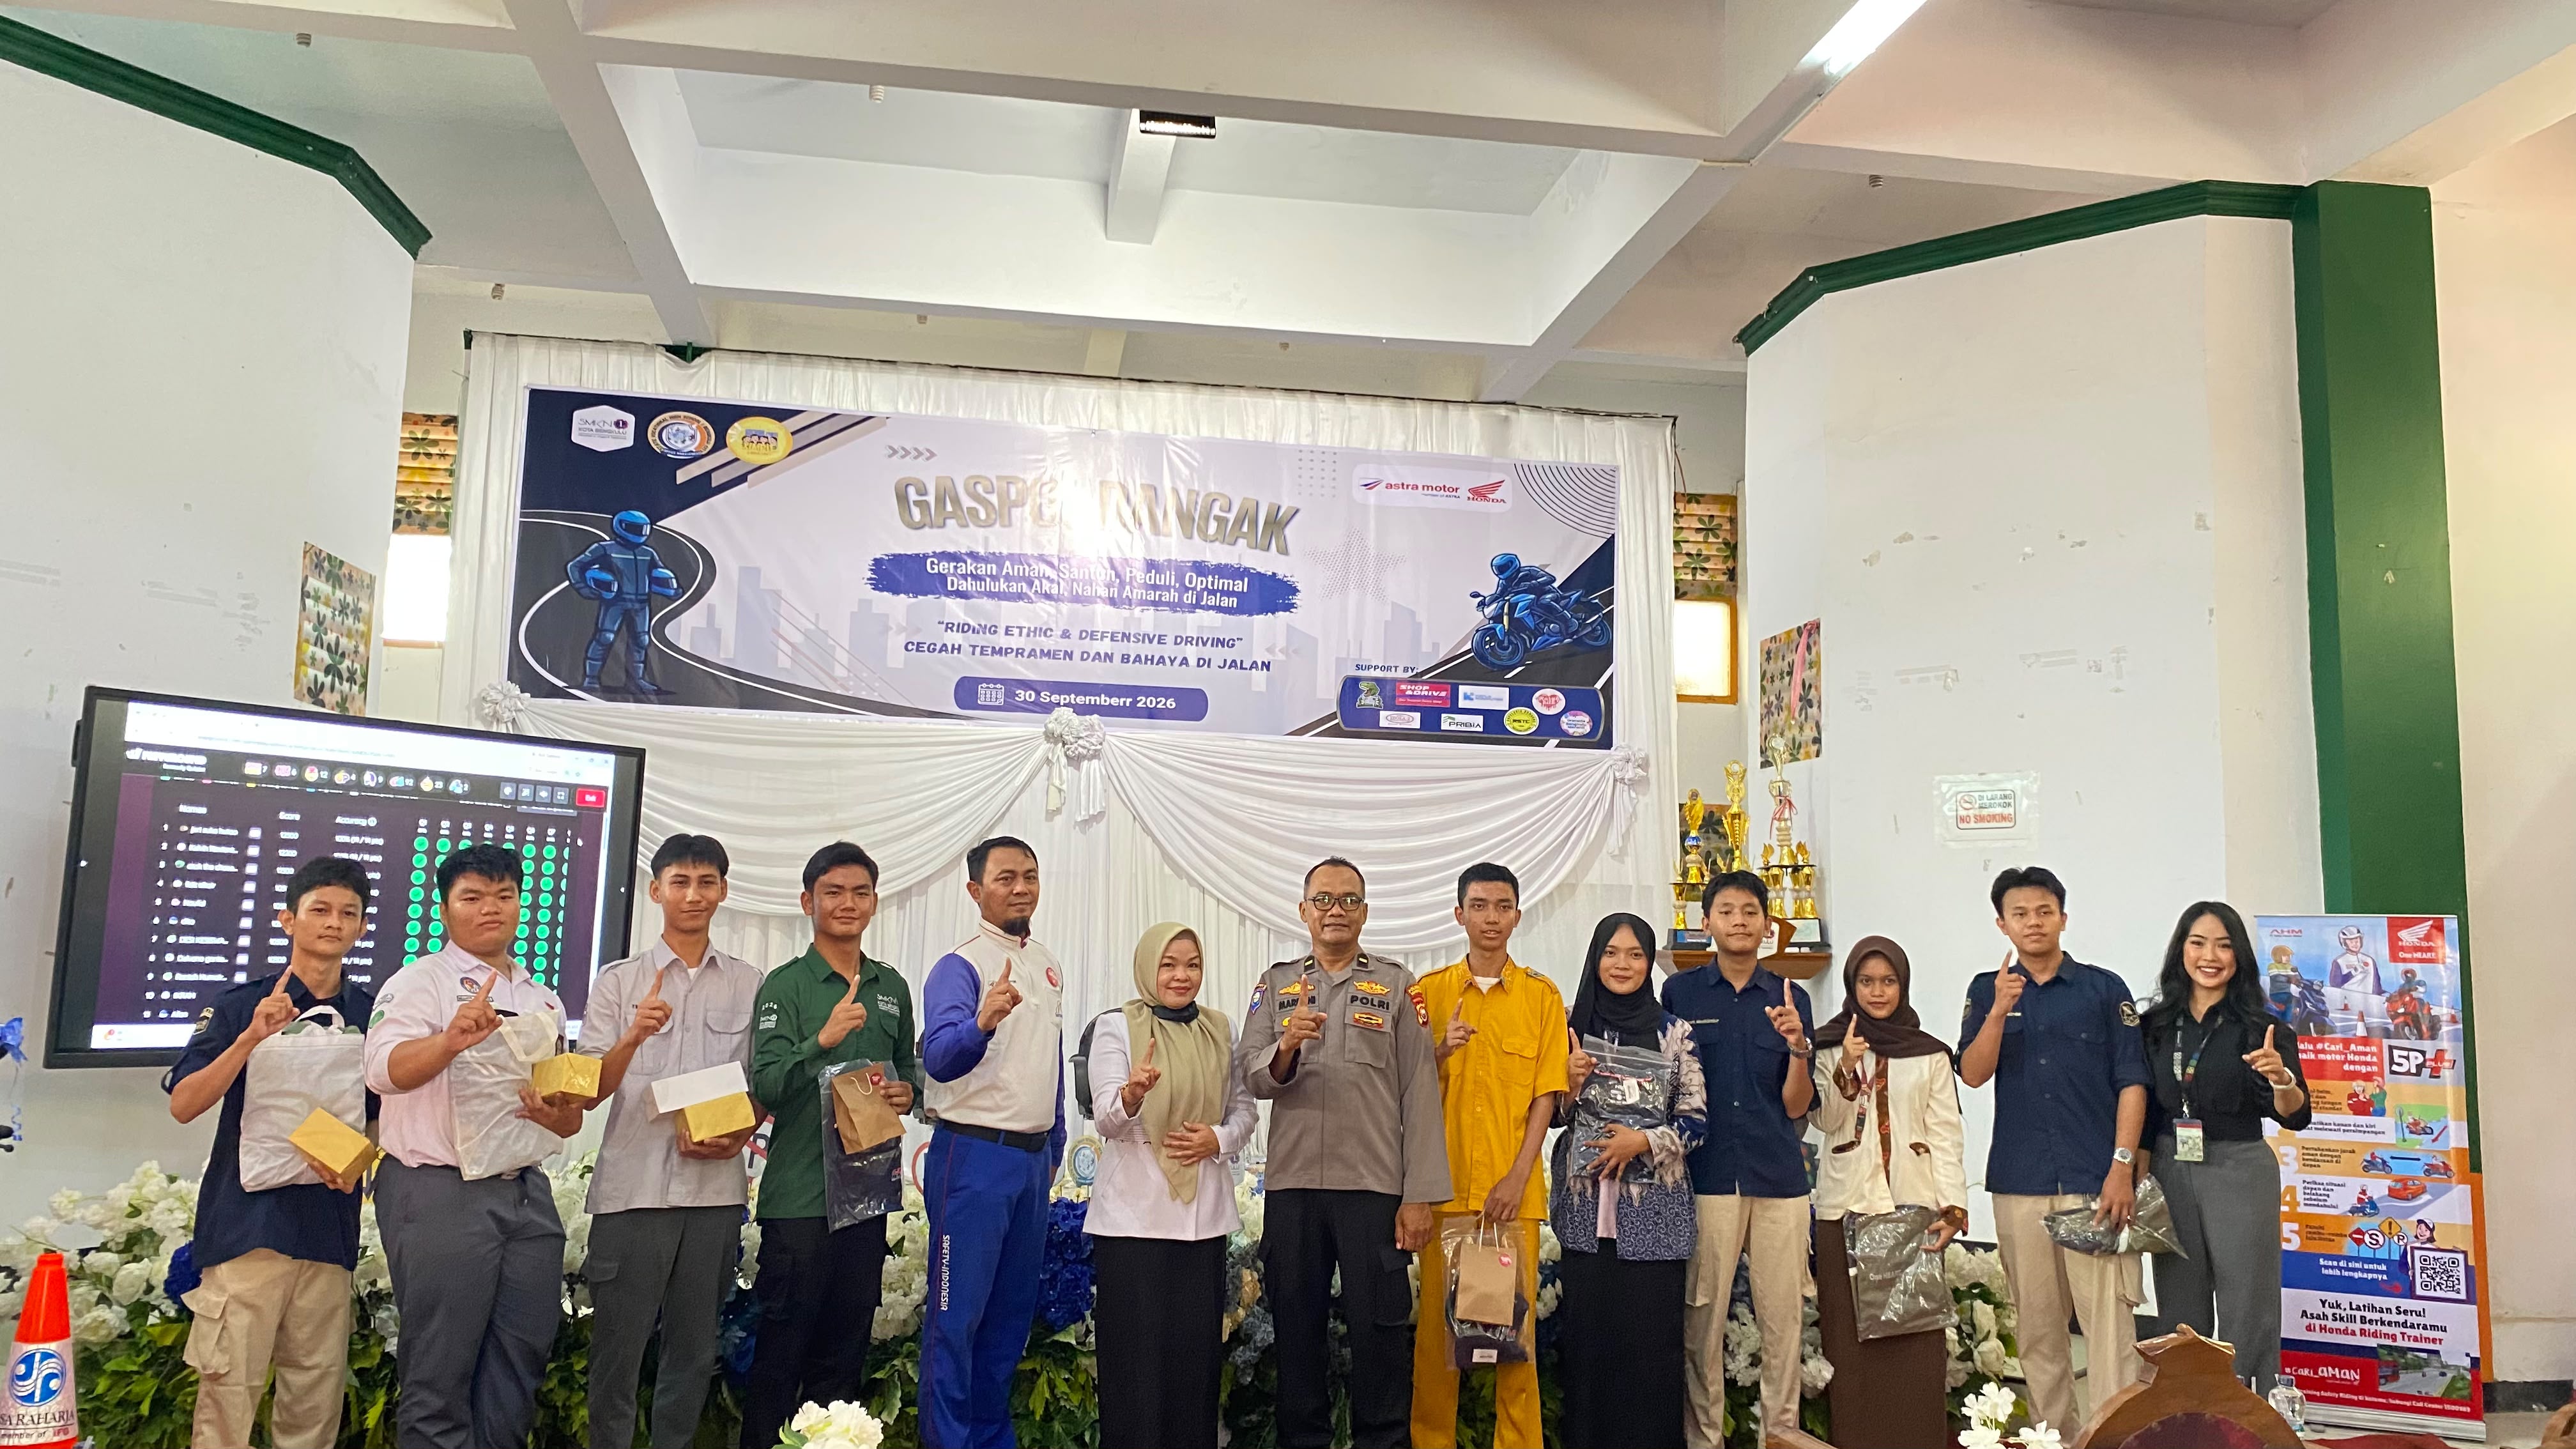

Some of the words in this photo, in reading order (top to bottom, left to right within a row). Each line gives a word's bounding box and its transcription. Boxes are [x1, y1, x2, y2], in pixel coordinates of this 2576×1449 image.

[1385, 482, 1419, 491] astra
[1422, 484, 1460, 493] motor
[926, 558, 997, 576] Gerakan
[1125, 568, 1179, 589] Peduli,
[1184, 573, 1249, 595] Optimal
[946, 577, 1027, 594] Dahulukan
[1031, 579, 1066, 597] Akal,
[1071, 581, 1119, 599] Nahan
[1122, 585, 1179, 604] Amarah
[1183, 588, 1197, 604] di
[1200, 590, 1238, 609] Jalan
[1004, 625, 1053, 640] ETHIC
[1060, 628, 1072, 640] &
[1078, 629, 1168, 647] DEFENSIVE
[903, 640, 962, 657] CEGAH
[969, 645, 1073, 663] TEMPRAMEN
[1080, 650, 1115, 665] DAN
[1120, 652, 1190, 670] BAHAYA
[1195, 656, 1213, 671] DI
[1217, 658, 1272, 673] JALAN
[1355, 664, 1400, 673] SUPPORT
[1014, 689, 1036, 703] 30
[1038, 690, 1133, 710] Septemberr
[1135, 696, 1177, 710] 2026
[1978, 801, 2012, 809] MEROKOK
[1959, 815, 1971, 824] NO
[1974, 813, 2012, 824] SMOKING
[1350, 994, 1390, 1011] POLRI
[2343, 1062, 2378, 1073] dengan
[2347, 1053, 2378, 1062] Honda
[2278, 1146, 2299, 1175] 3
[2281, 1185, 2300, 1212] 4
[2281, 1222, 2301, 1251] 5
[940, 1234, 950, 1311] SAFETY-INDONESIA
[2321, 1267, 2341, 1275] lebih
[2342, 1269, 2388, 1281] lengkapnya
[2339, 1259, 2347, 1267] di
[2348, 1260, 2363, 1269] sini
[2363, 1262, 2387, 1271] untuk
[2319, 1298, 2347, 1311] Yuk,
[2349, 1301, 2393, 1315] Latihan
[2395, 1306, 2426, 1318] Seru!
[2300, 1309, 2329, 1321] Asah
[2331, 1312, 2357, 1324] Skill
[2359, 1315, 2448, 1333] Berkendaramu
[2305, 1322, 2317, 1333] di
[2319, 1324, 2357, 1337] Honda
[2359, 1328, 2398, 1342] Riding
[2400, 1332, 2444, 1346] Trainer
[16, 1409, 75, 1427] RAHARJA
